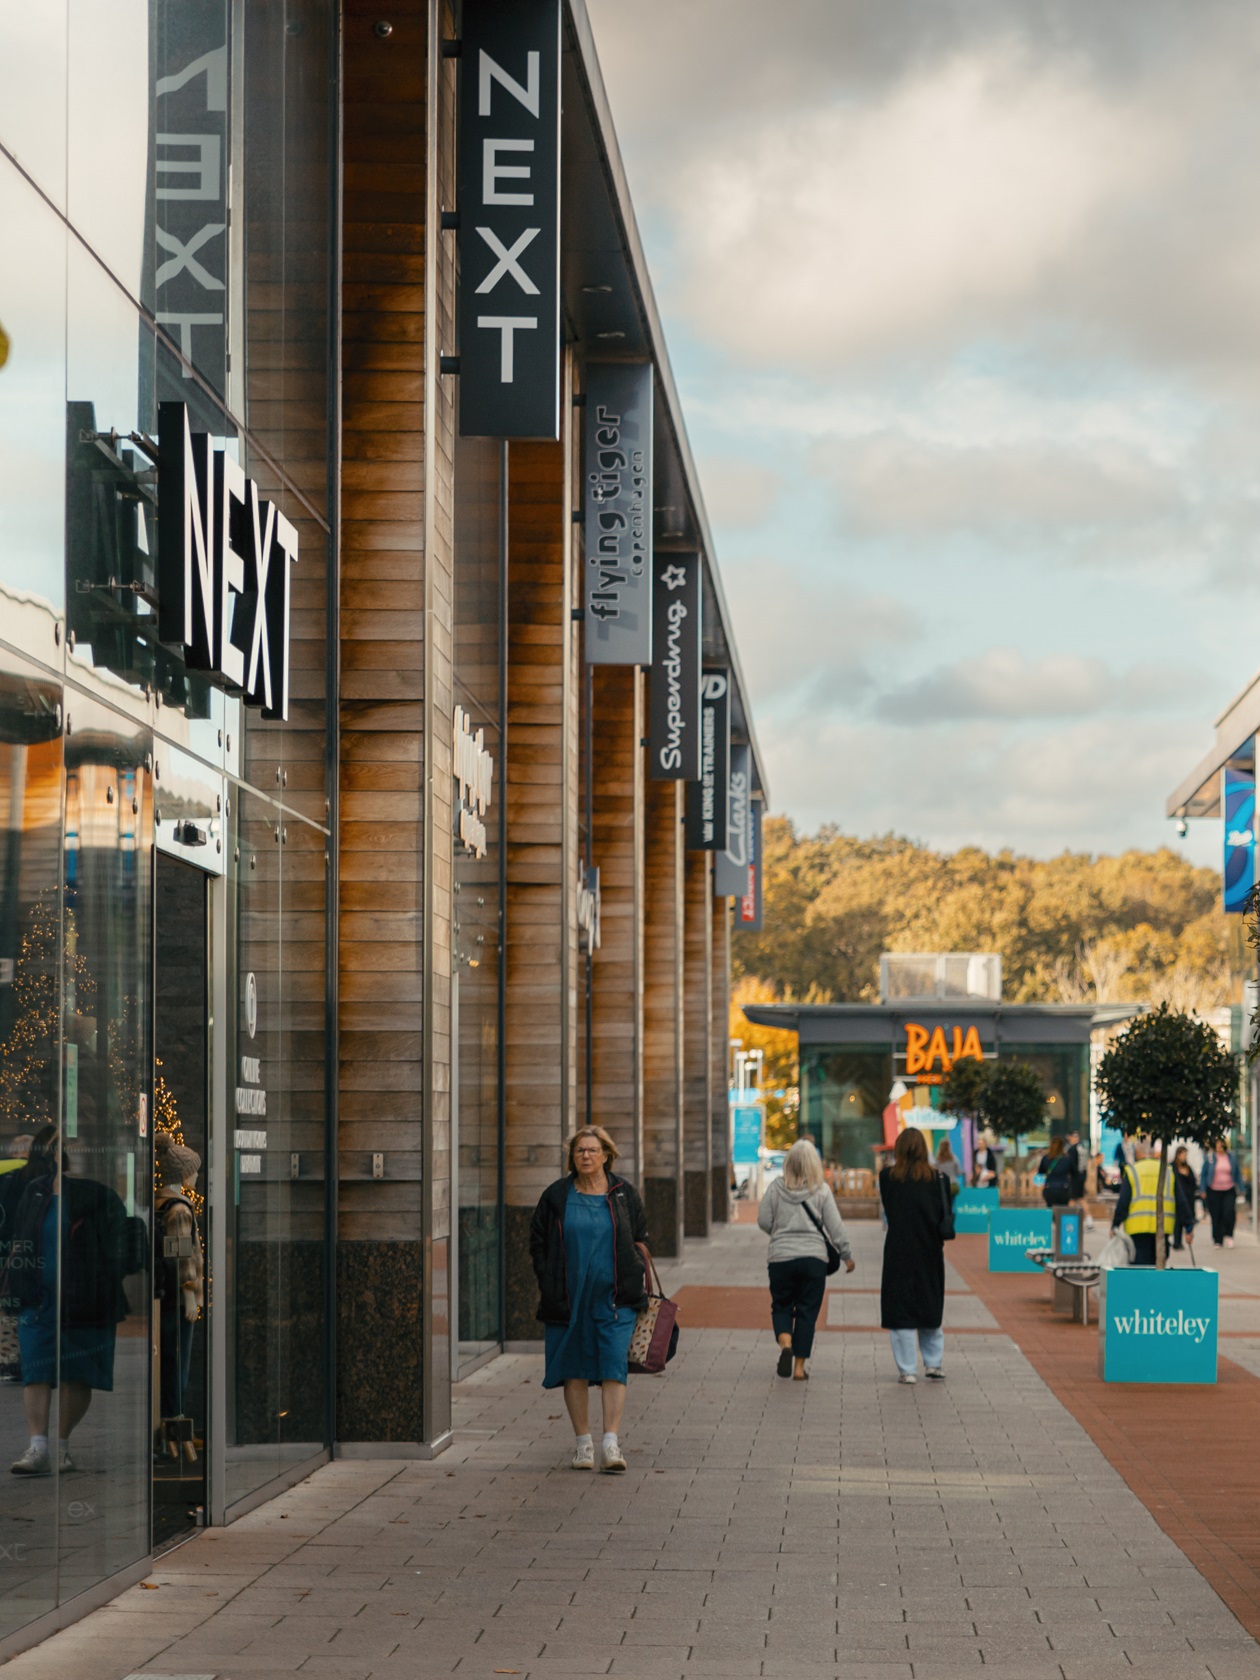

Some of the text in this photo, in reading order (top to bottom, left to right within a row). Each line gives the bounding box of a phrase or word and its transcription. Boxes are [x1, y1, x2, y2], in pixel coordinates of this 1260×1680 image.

[474, 48, 542, 384] NEXT
[180, 402, 299, 721] NEXT
[589, 406, 626, 621] flying tiger
[630, 450, 648, 577] copenhagen
[660, 600, 688, 770] Superdrug
[702, 707, 715, 773] TRAINERS
[904, 1023, 983, 1075] BAJA
[1113, 1308, 1211, 1343] whiteley
